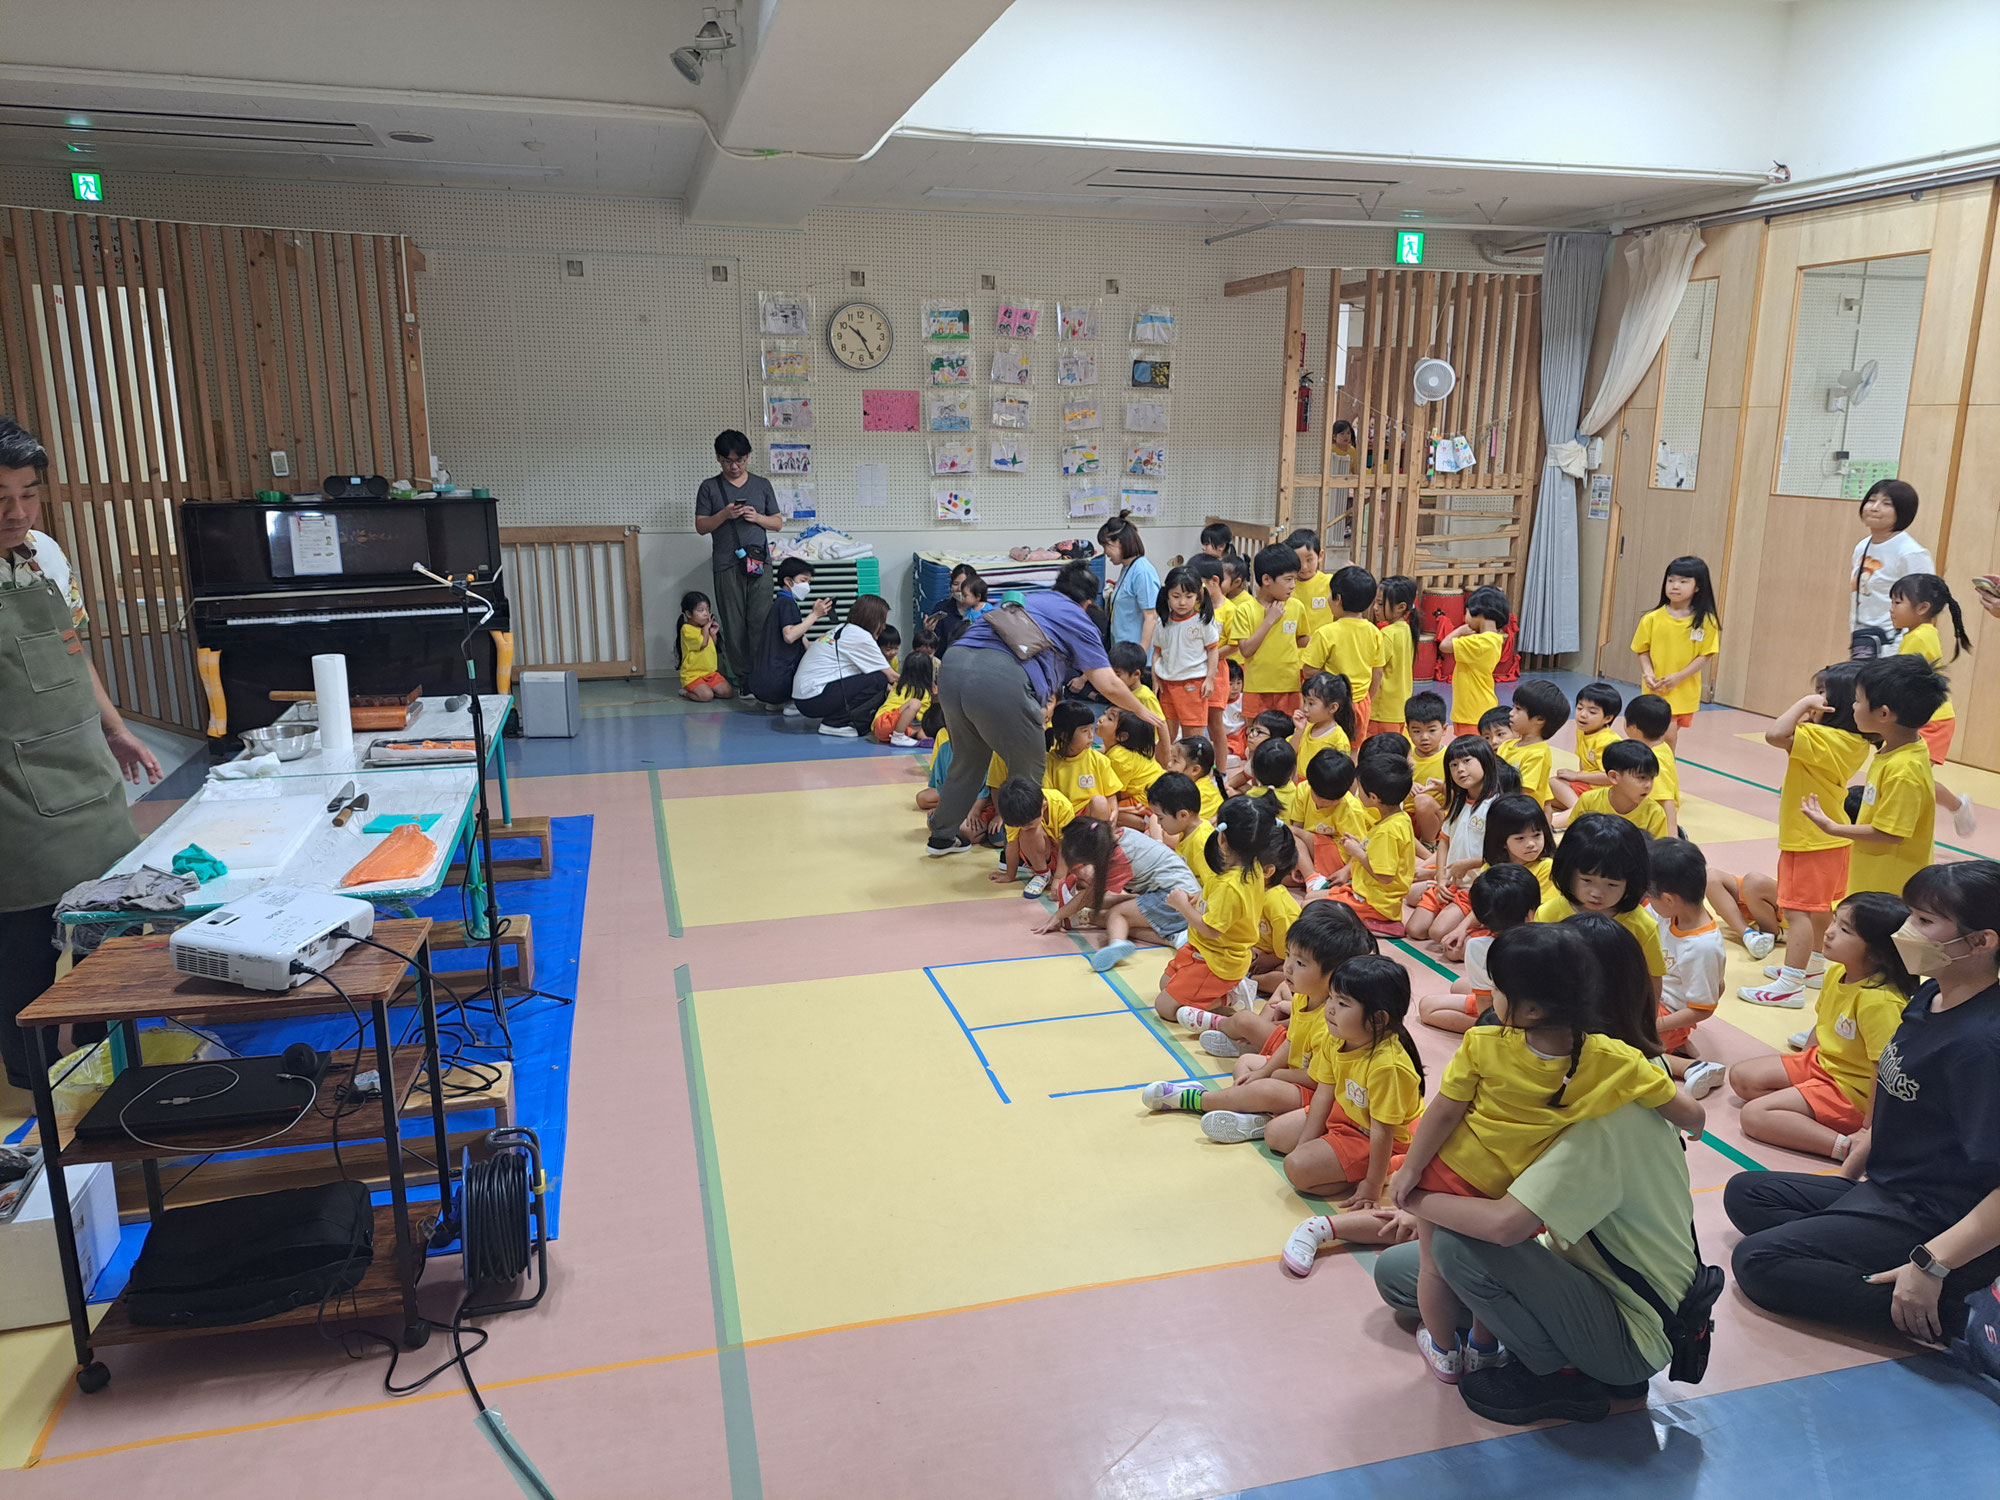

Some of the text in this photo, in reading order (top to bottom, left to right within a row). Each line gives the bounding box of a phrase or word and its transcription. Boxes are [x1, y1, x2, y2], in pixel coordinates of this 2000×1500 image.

[848, 314, 854, 322] 11
[856, 311, 865, 320] 12
[870, 314, 873, 322] 1
[840, 322, 848, 330] 10
[876, 322, 882, 331] 2
[836, 332, 843, 340] 9
[879, 333, 885, 341] 3
[841, 343, 847, 352] 8
[876, 344, 881, 352] 4
[849, 351, 855, 360] 7
